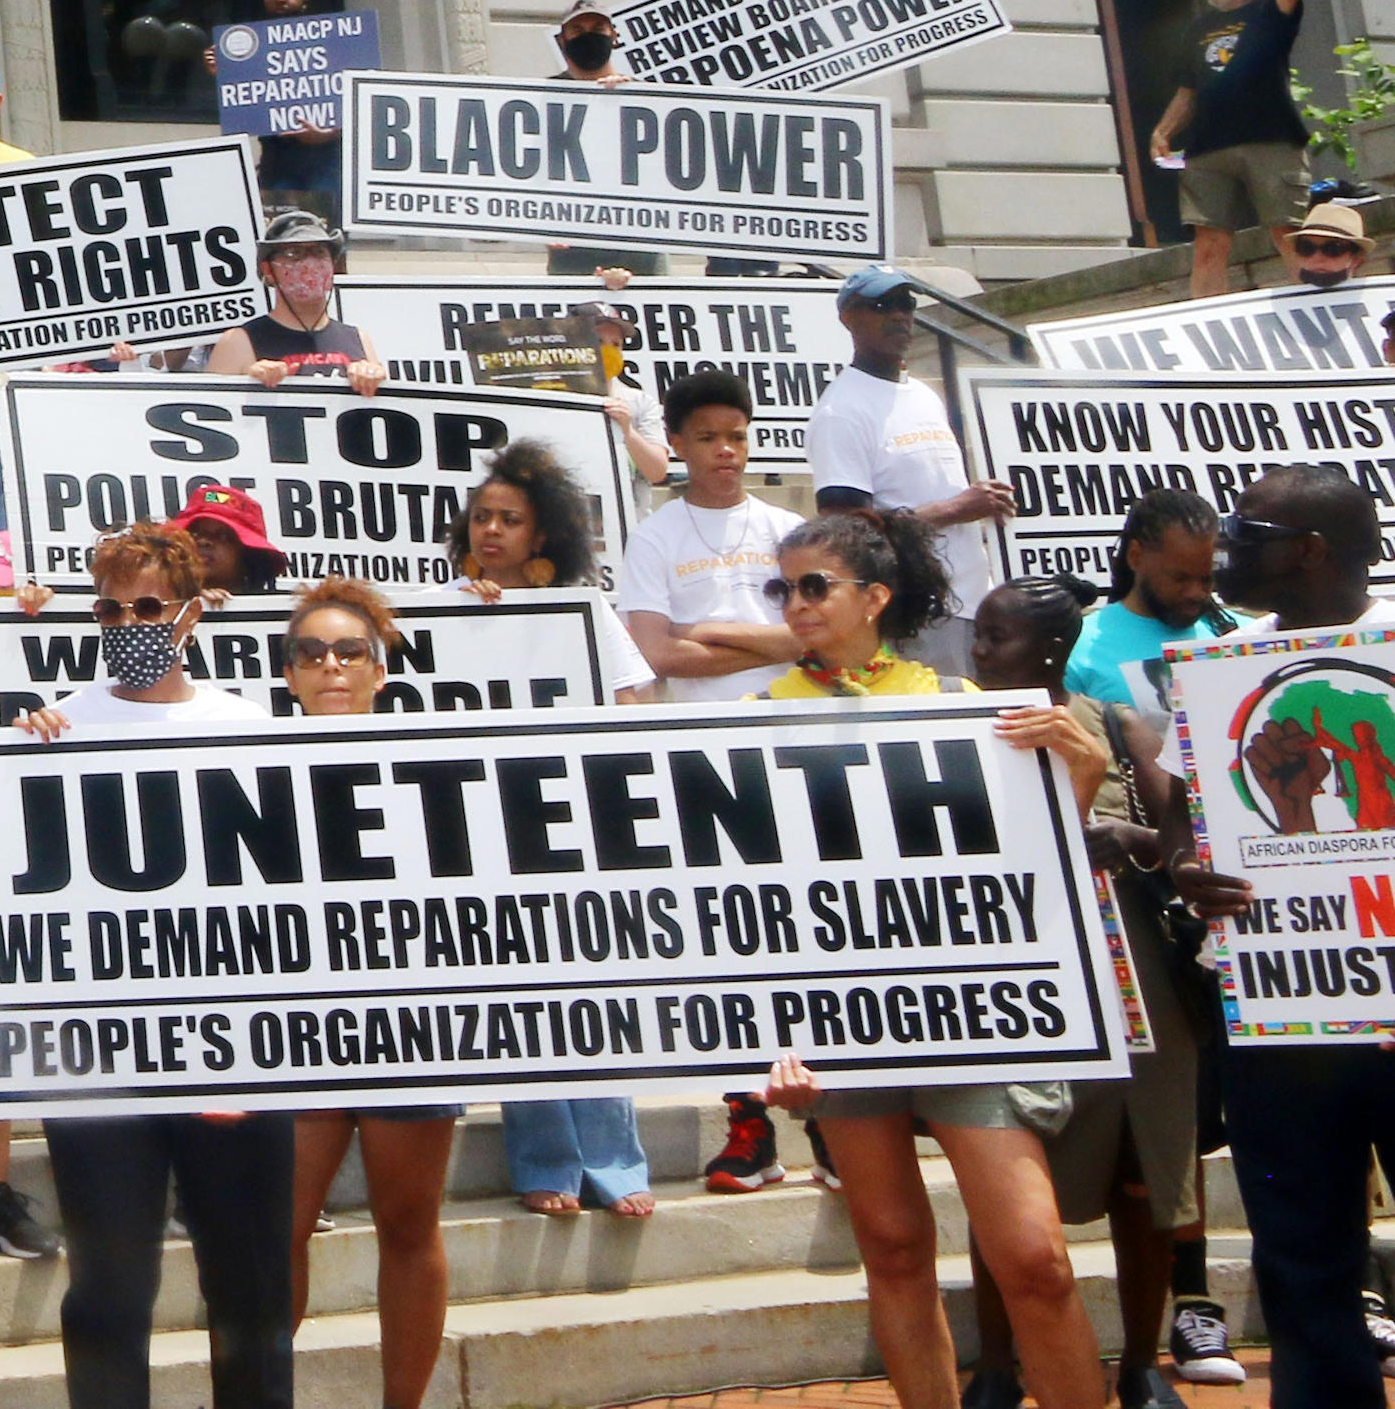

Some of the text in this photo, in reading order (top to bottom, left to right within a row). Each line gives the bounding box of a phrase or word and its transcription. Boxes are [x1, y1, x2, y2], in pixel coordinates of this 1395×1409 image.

[267, 16, 362, 44] NAACP NJ
[625, 10, 753, 75] REVIEW
[858, 8, 989, 67] FOR PROGRESS
[266, 46, 328, 76] SAYS
[269, 102, 335, 133] NOW!
[370, 94, 864, 201] BLACK POWER
[368, 192, 868, 244] PEOPLE'S ORGANIZATION FOR PROGRESS
[13, 225, 248, 312] RIGHTS
[74, 296, 256, 341] FOR PROGRESS
[707, 303, 797, 353] THE
[1183, 302, 1385, 370] WANT
[145, 402, 508, 472] STOP
[1011, 401, 1288, 453] KNOW YOUR
[12, 739, 1000, 895] JUNETEENTH
[1247, 835, 1379, 858] AFRICAN DIASPORA
[88, 903, 312, 982] DEMAND
[324, 889, 684, 973] REPARATIONS
[694, 883, 800, 957] FOR
[809, 872, 1038, 953] SLAVERY
[1235, 893, 1348, 936] WE SAY
[250, 997, 644, 1069] ORGANIZATION
[656, 992, 760, 1053] FOR
[771, 978, 1067, 1050] PROGRESS
